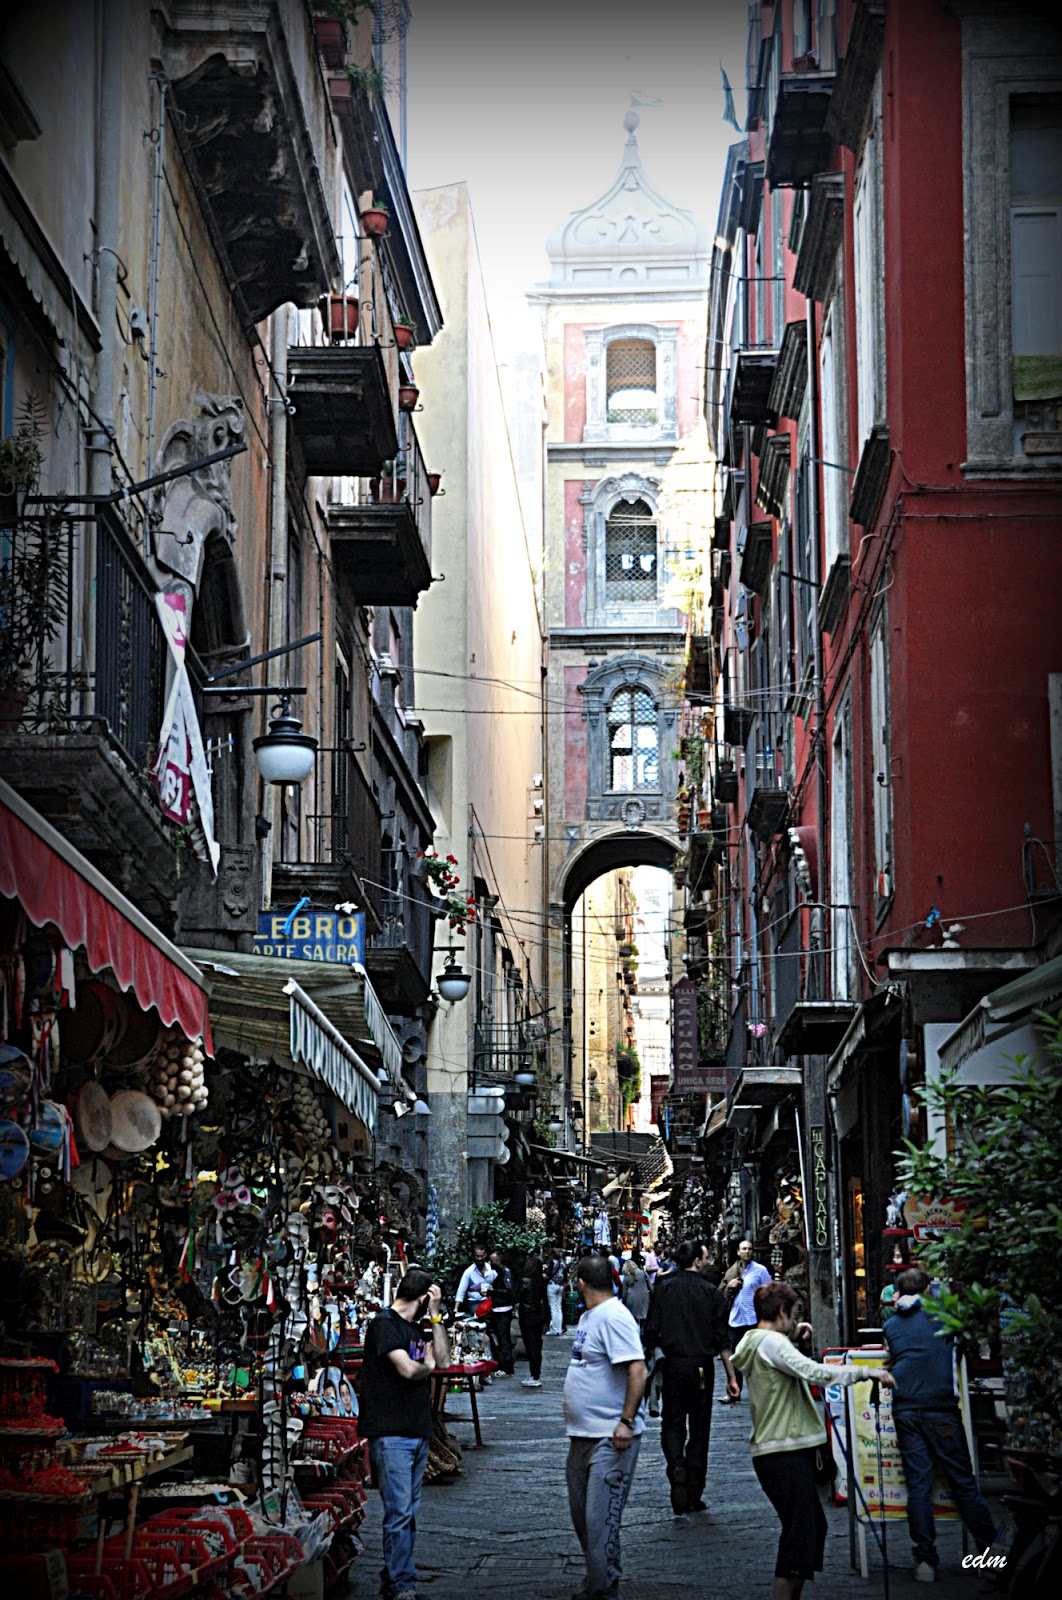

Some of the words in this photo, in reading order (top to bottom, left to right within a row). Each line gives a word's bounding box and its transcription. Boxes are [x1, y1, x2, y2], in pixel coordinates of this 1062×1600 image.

[302, 943, 359, 961] SACRA
[677, 997, 694, 1071] CAPUANO
[677, 1076, 704, 1085] UNICA
[812, 1142, 828, 1246] CAPUANO
[924, 1207, 952, 1220] JACKPOT
